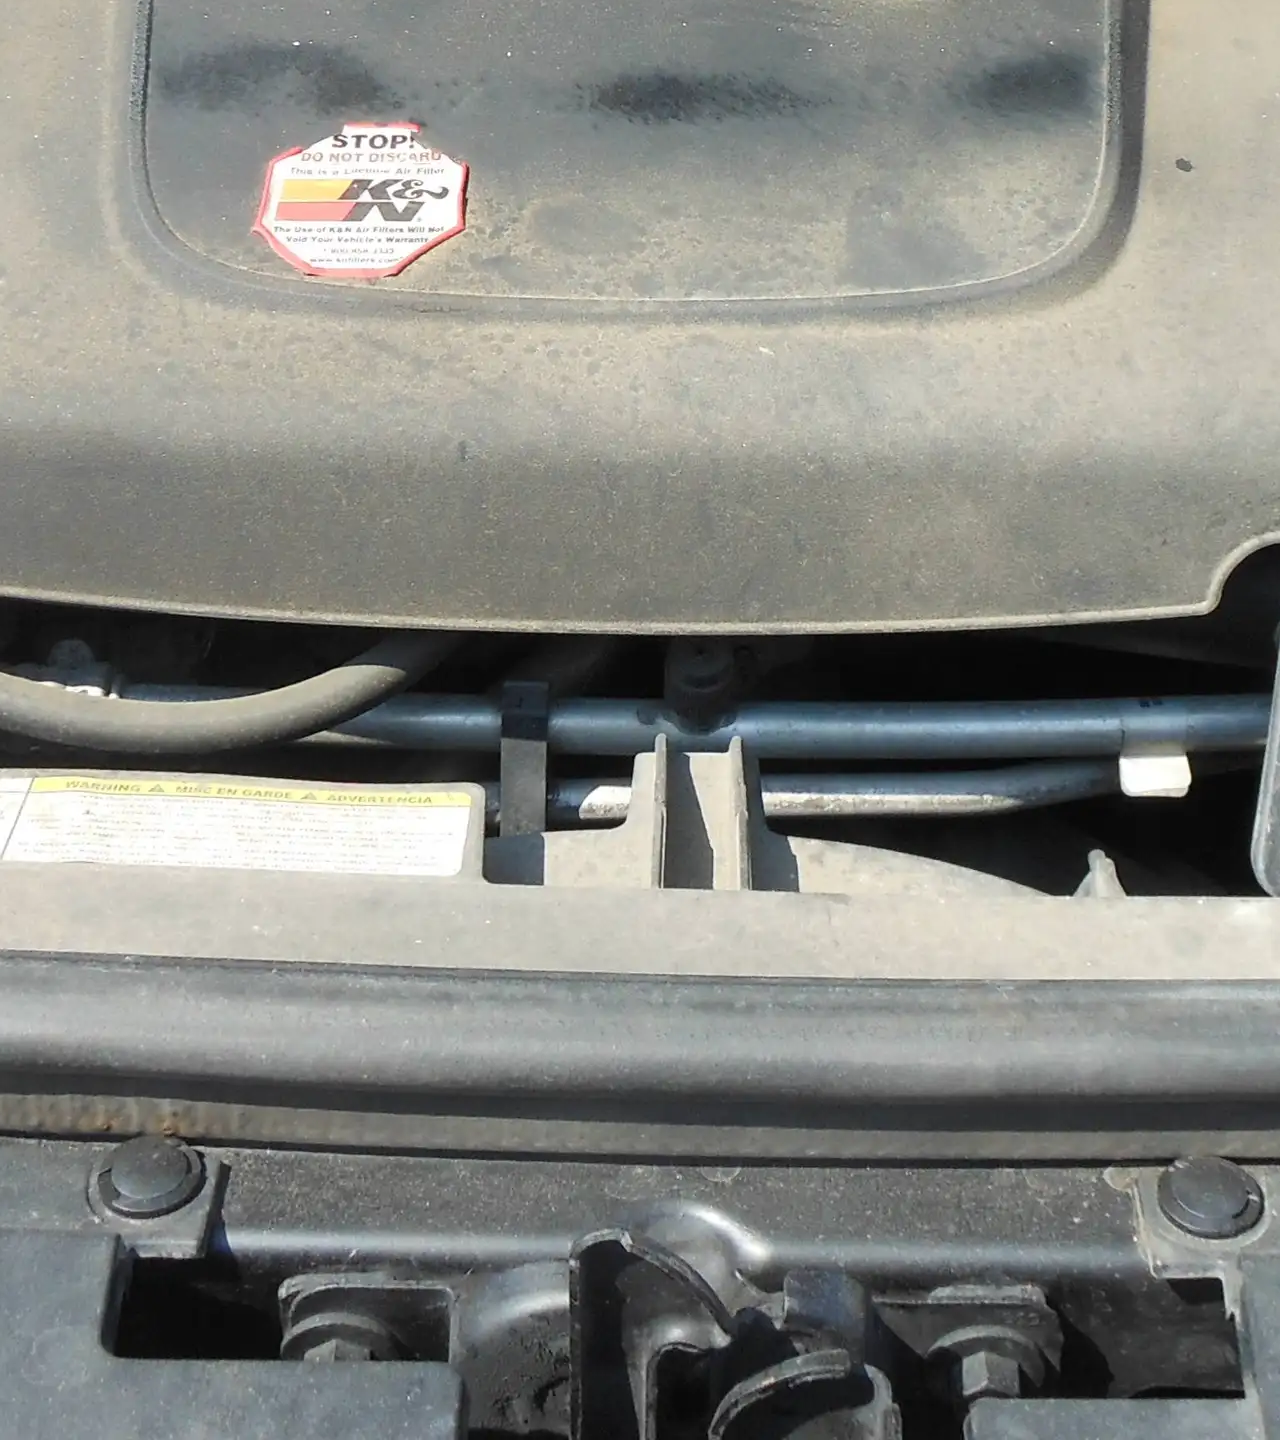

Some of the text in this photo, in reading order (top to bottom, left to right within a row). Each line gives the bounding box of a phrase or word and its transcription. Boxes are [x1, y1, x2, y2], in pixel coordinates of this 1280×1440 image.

[331, 134, 415, 150] STOP!
[301, 152, 443, 164] DO NOT DISCARD
[395, 167, 412, 175] Air
[64, 781, 141, 792] WARNING
[216, 787, 238, 796] EN
[241, 789, 294, 800] GARDE
[326, 793, 433, 805] ADVERTENCIA
